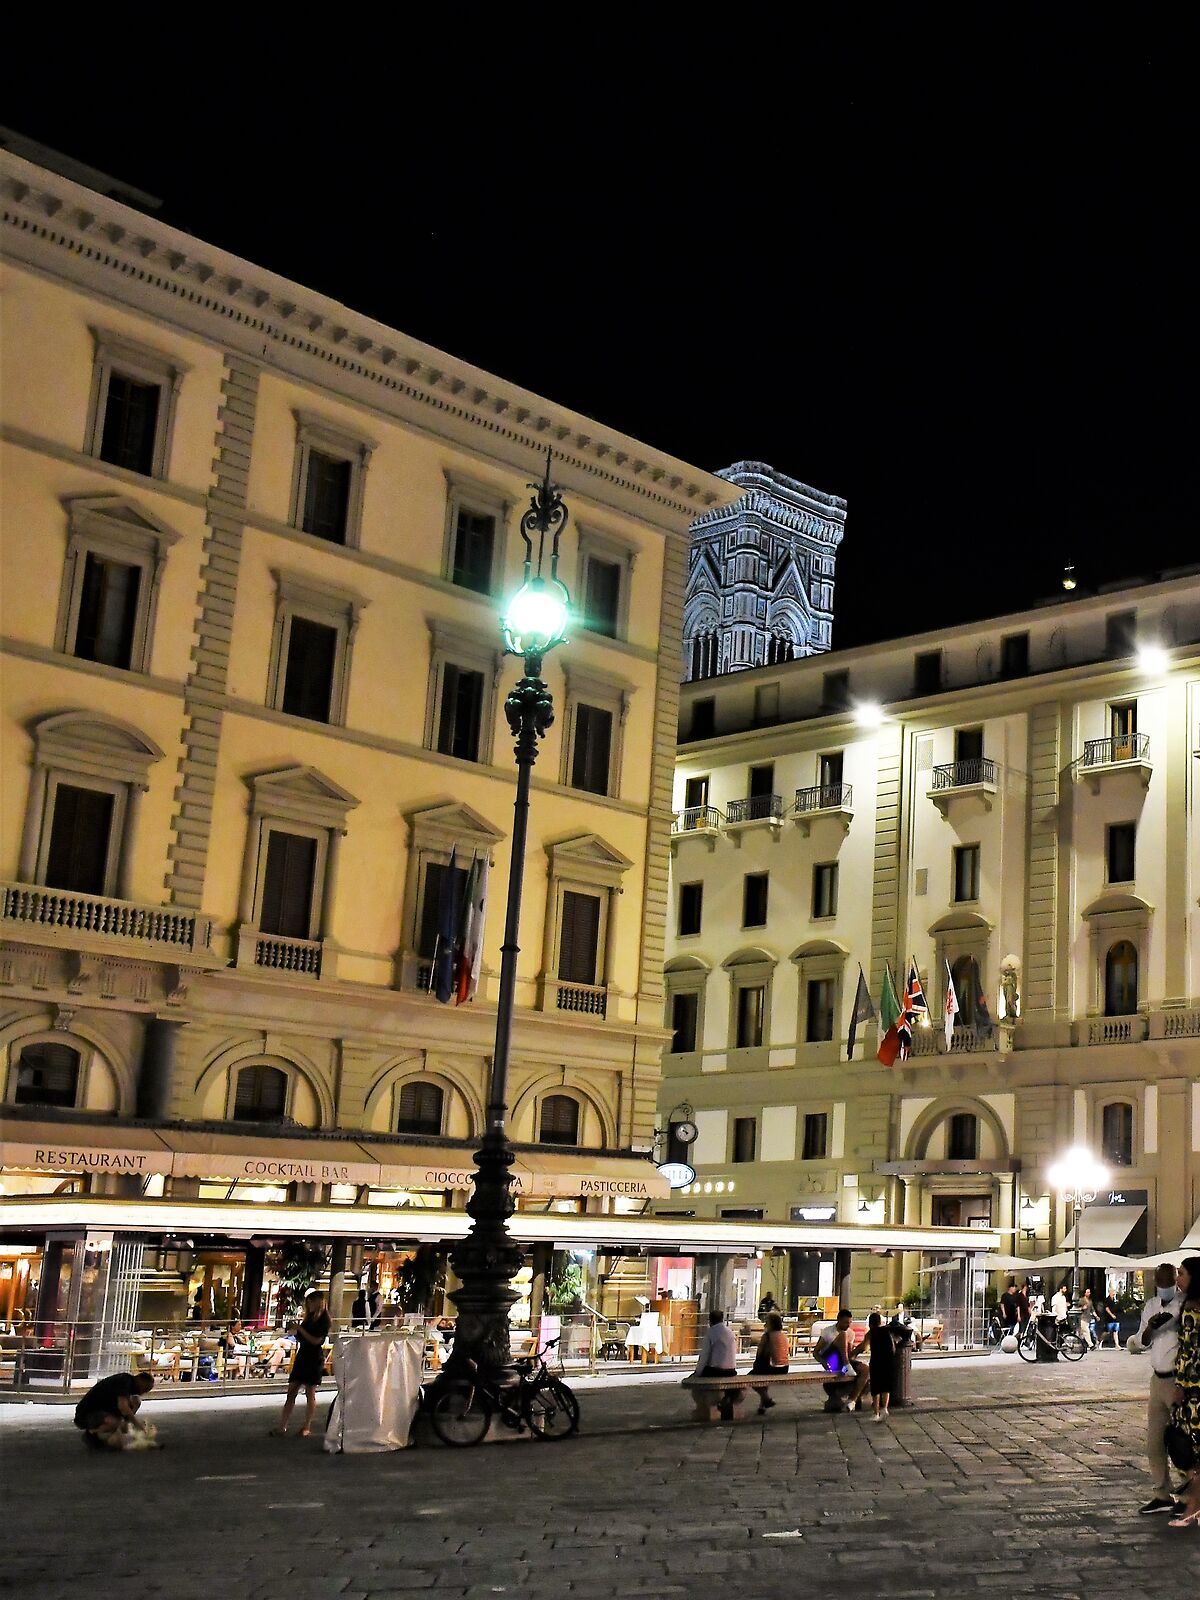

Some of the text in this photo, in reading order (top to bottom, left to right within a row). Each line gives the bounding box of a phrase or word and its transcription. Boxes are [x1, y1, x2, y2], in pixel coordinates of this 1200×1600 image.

[35, 1150, 147, 1169] RESTAURANT
[244, 1161, 349, 1179] COCKTAIL BAR
[580, 1180, 648, 1193] PASTICCERIA
